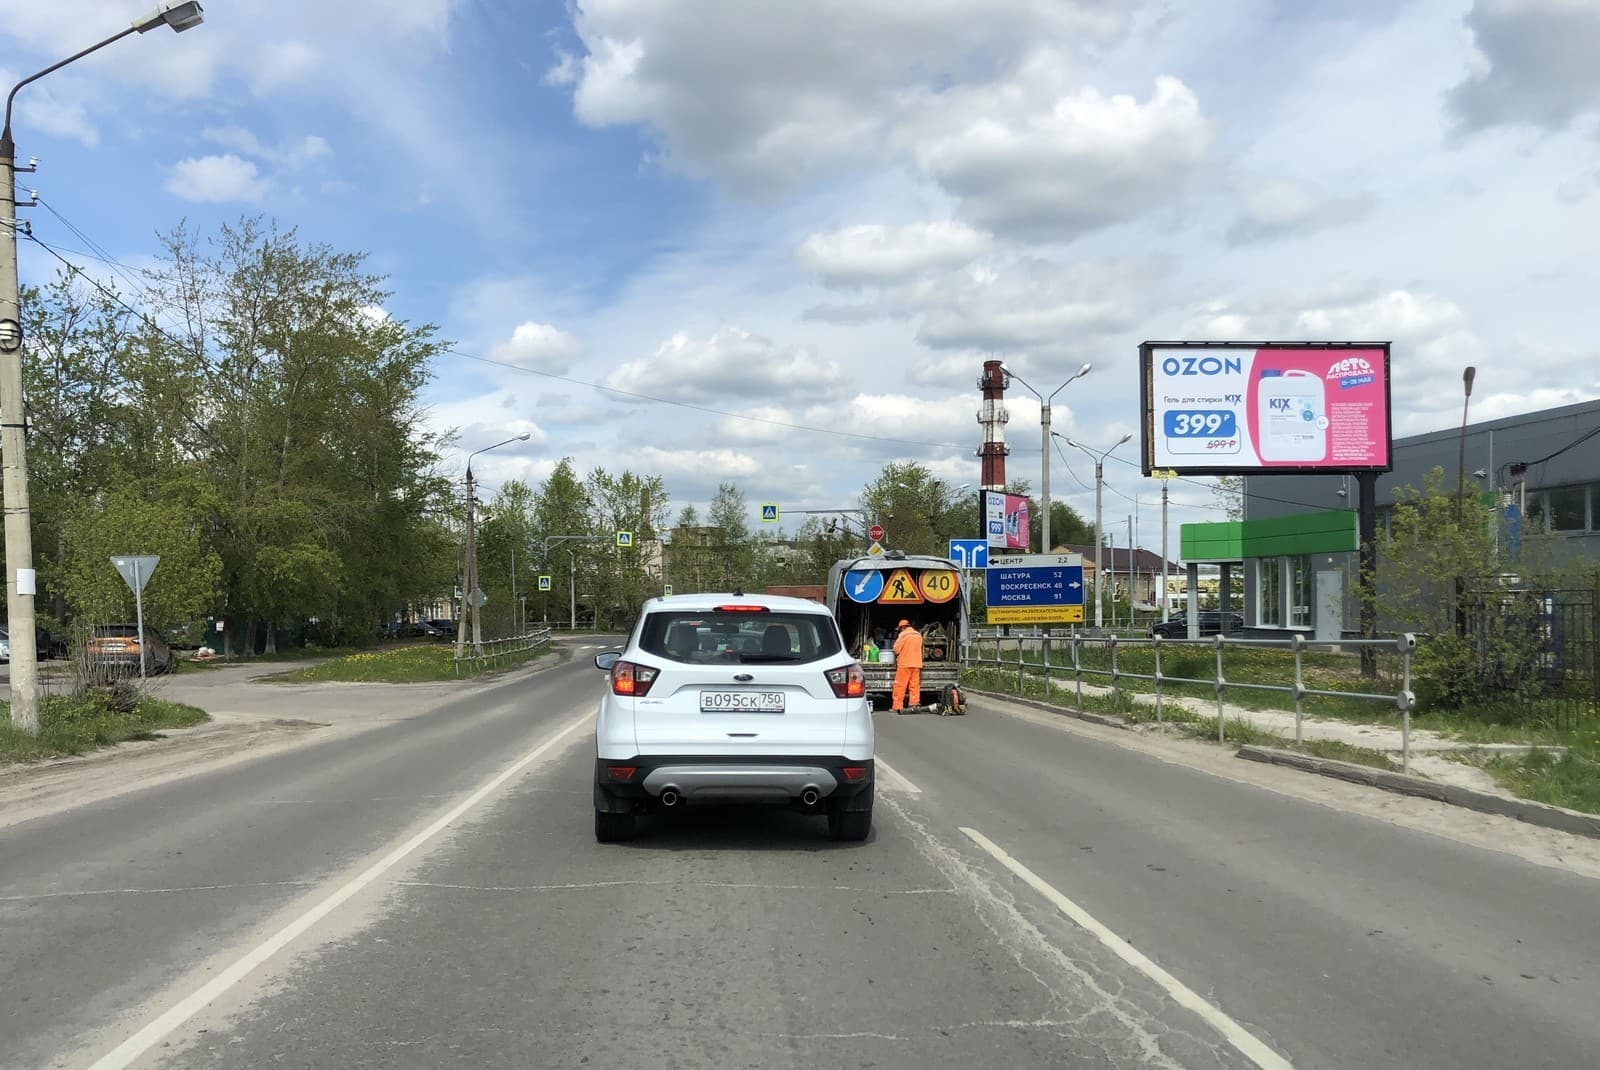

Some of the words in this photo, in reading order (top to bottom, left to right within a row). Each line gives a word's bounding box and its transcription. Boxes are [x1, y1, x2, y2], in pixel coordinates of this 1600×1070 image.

[1162, 356, 1241, 376] OZON
[1224, 394, 1242, 406] KIX
[1269, 398, 1291, 413] KIX
[1000, 572, 1031, 580] ШАТУРА
[926, 575, 950, 591] 40
[1000, 582, 1052, 591] ВОСКРЕСЕНСК
[761, 693, 781, 704] 750
